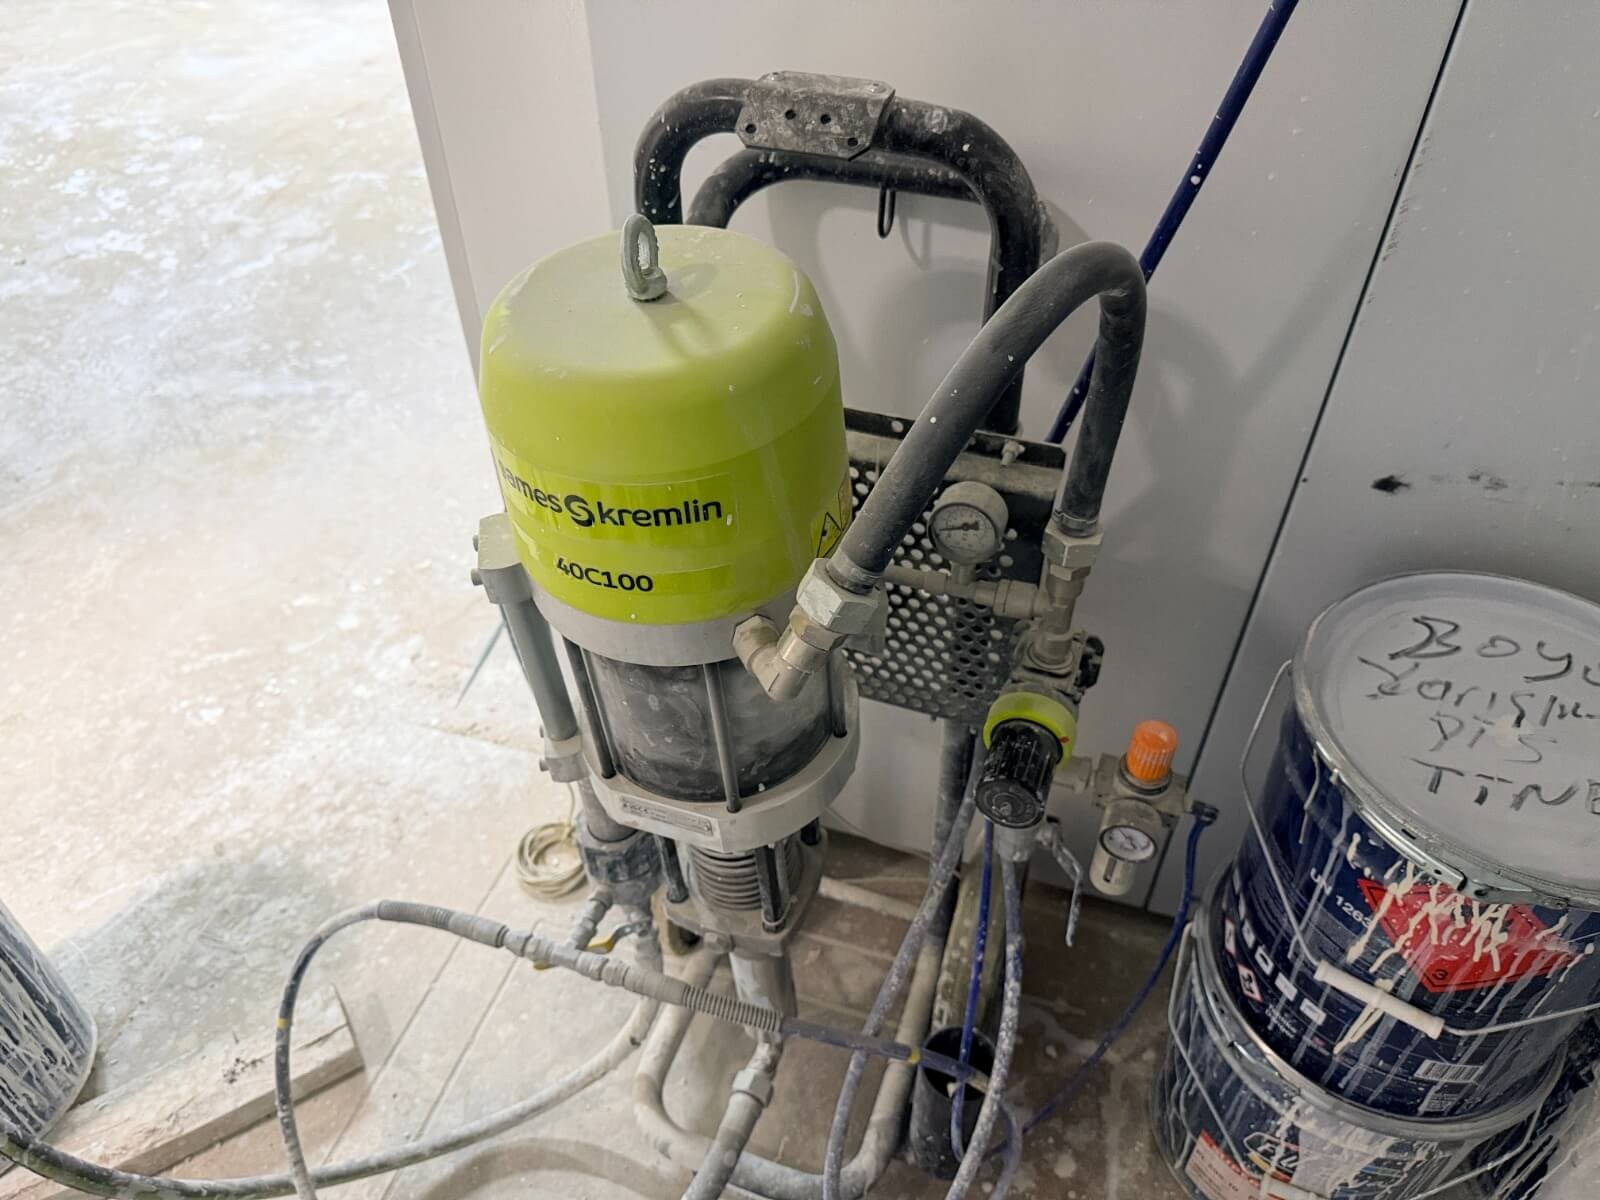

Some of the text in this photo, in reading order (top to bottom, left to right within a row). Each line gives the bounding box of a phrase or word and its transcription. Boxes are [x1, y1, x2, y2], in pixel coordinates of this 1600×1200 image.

[597, 499, 723, 527] kremlin
[555, 557, 654, 592] 40C100
[1431, 968, 1449, 981] 3
